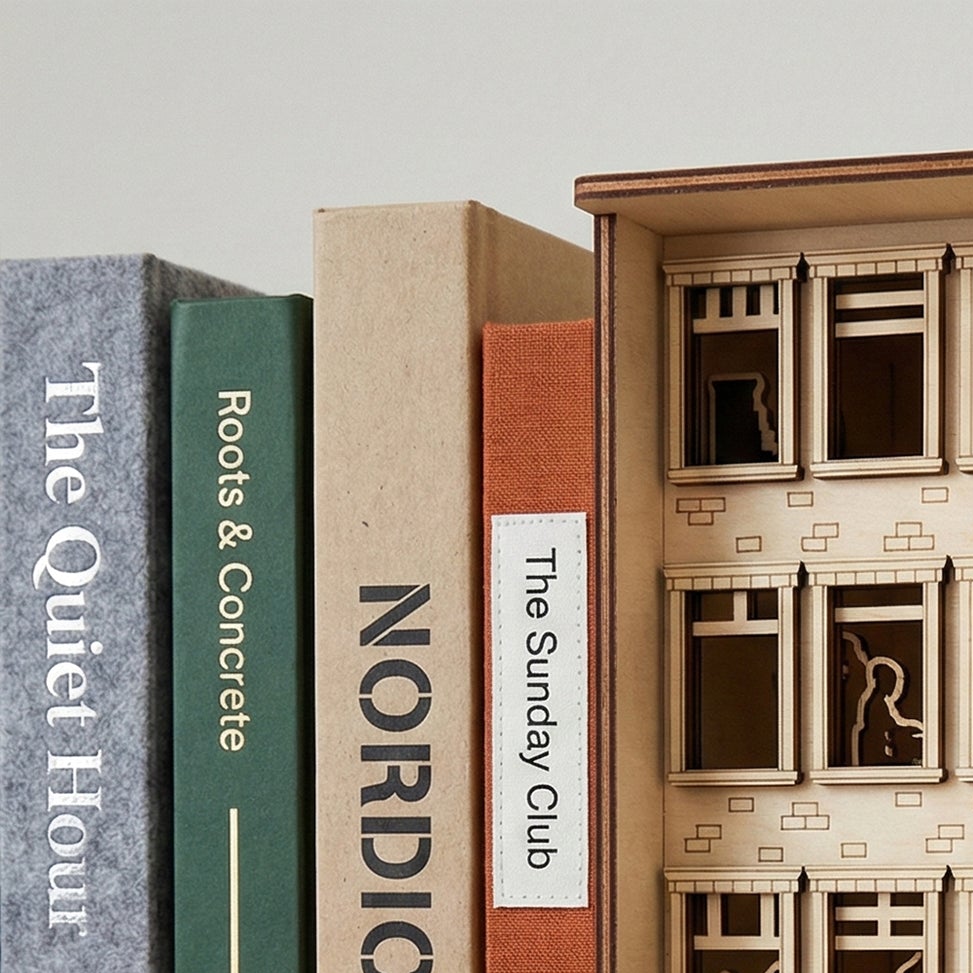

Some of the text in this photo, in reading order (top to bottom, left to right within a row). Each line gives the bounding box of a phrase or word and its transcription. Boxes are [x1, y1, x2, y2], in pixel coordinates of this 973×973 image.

[32, 362, 104, 937] The Quiet Hour
[217, 389, 253, 752] Roots & Concrete
[518, 547, 558, 870] The Sunday Club
